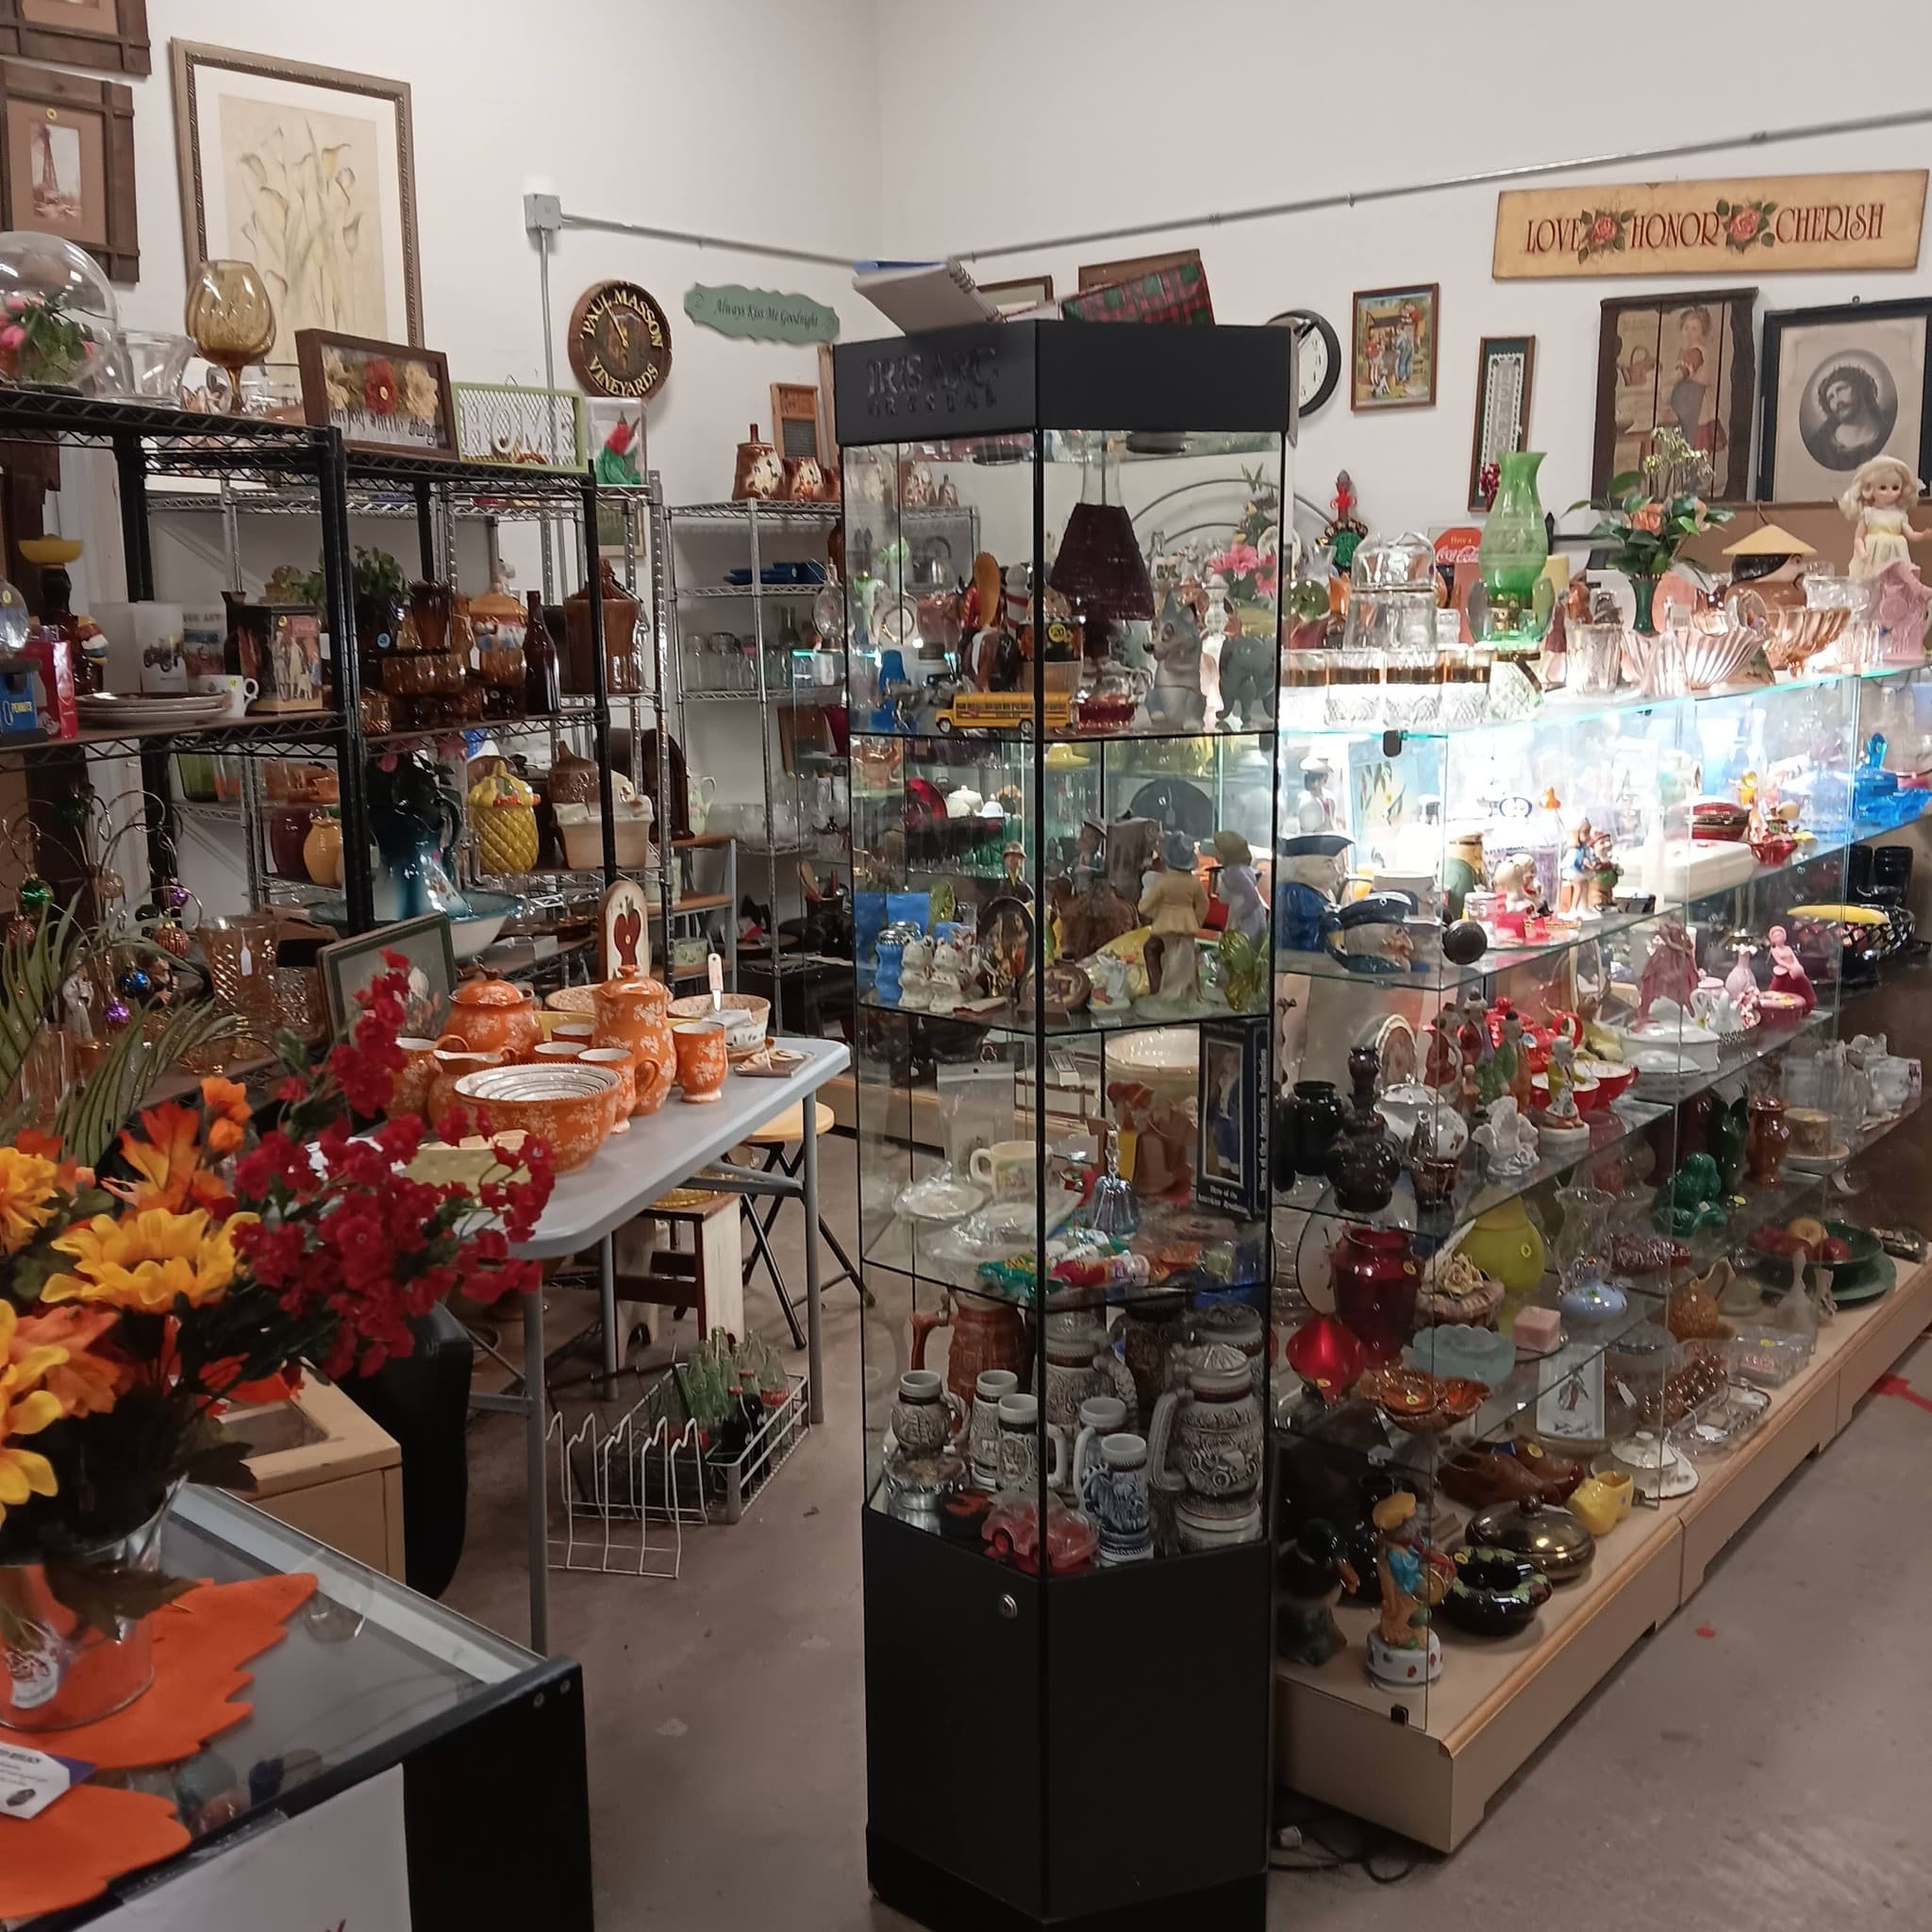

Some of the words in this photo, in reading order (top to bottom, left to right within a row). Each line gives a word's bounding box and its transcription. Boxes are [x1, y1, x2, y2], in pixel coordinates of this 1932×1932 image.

[1524, 217, 1582, 255] LOVE
[1629, 210, 1720, 250] HONOR
[1775, 203, 1886, 243] CHERISH
[581, 293, 612, 339] PAUL
[613, 289, 663, 348] MASSON
[714, 299, 746, 320] Always
[747, 304, 764, 322] Kiss
[767, 307, 779, 322] Me
[589, 353, 658, 397] VINEYARDS
[462, 401, 576, 457] HOME
